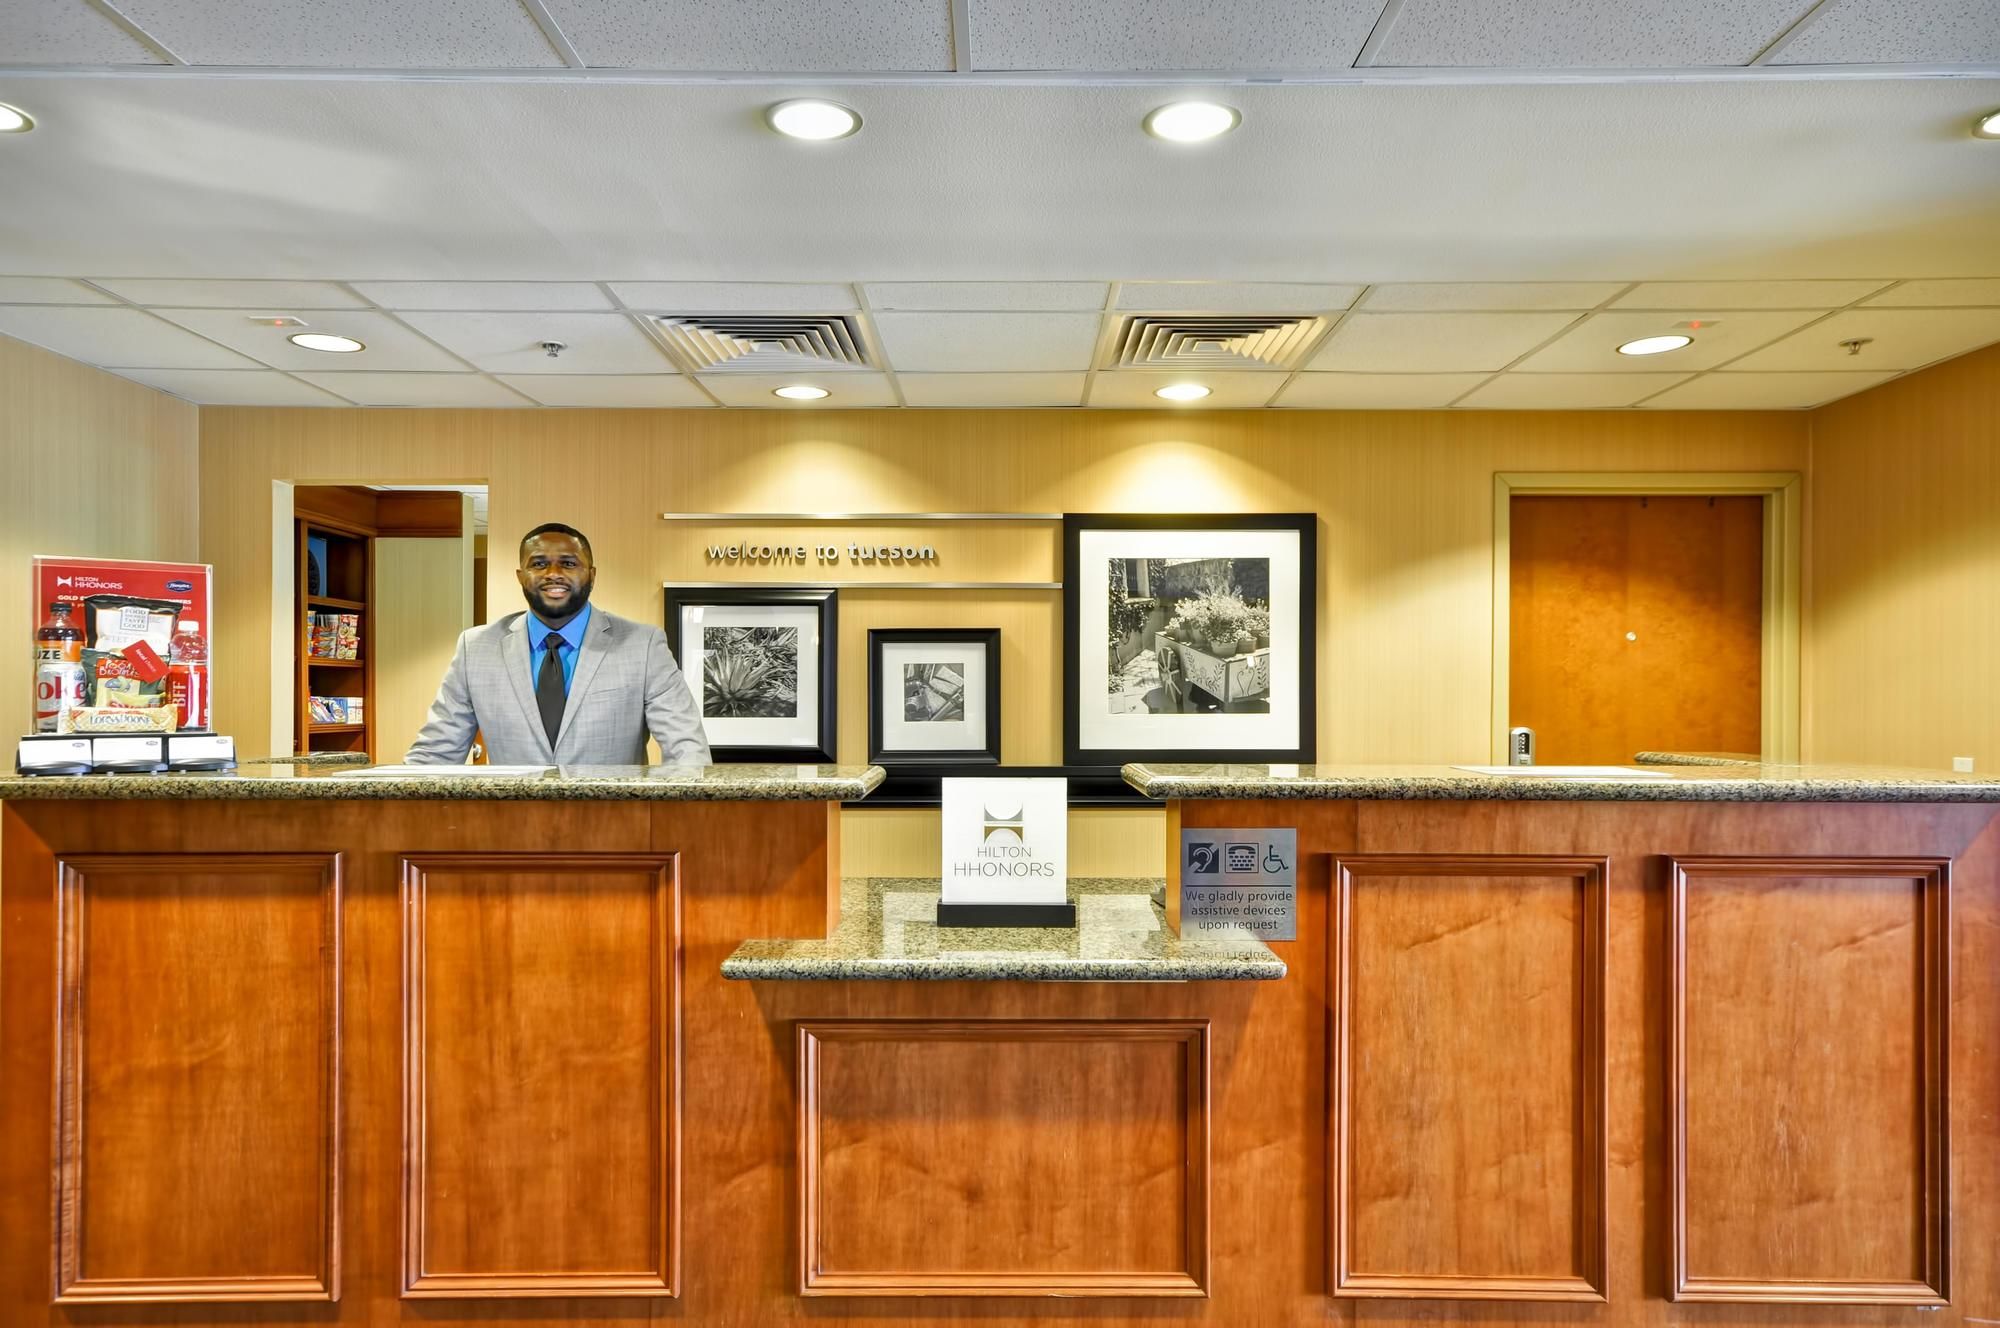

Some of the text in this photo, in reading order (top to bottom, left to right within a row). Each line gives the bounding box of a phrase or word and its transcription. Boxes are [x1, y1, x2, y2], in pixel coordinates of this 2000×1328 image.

[708, 541, 934, 561] welcome to tucson
[75, 581, 123, 590] HHONORS
[977, 846, 1032, 858] HILTON
[954, 862, 1055, 877] HHONORS
[1185, 890, 1293, 904] We gladly provide
[1191, 904, 1286, 916] assistive devices
[1199, 920, 1279, 932] upon request
